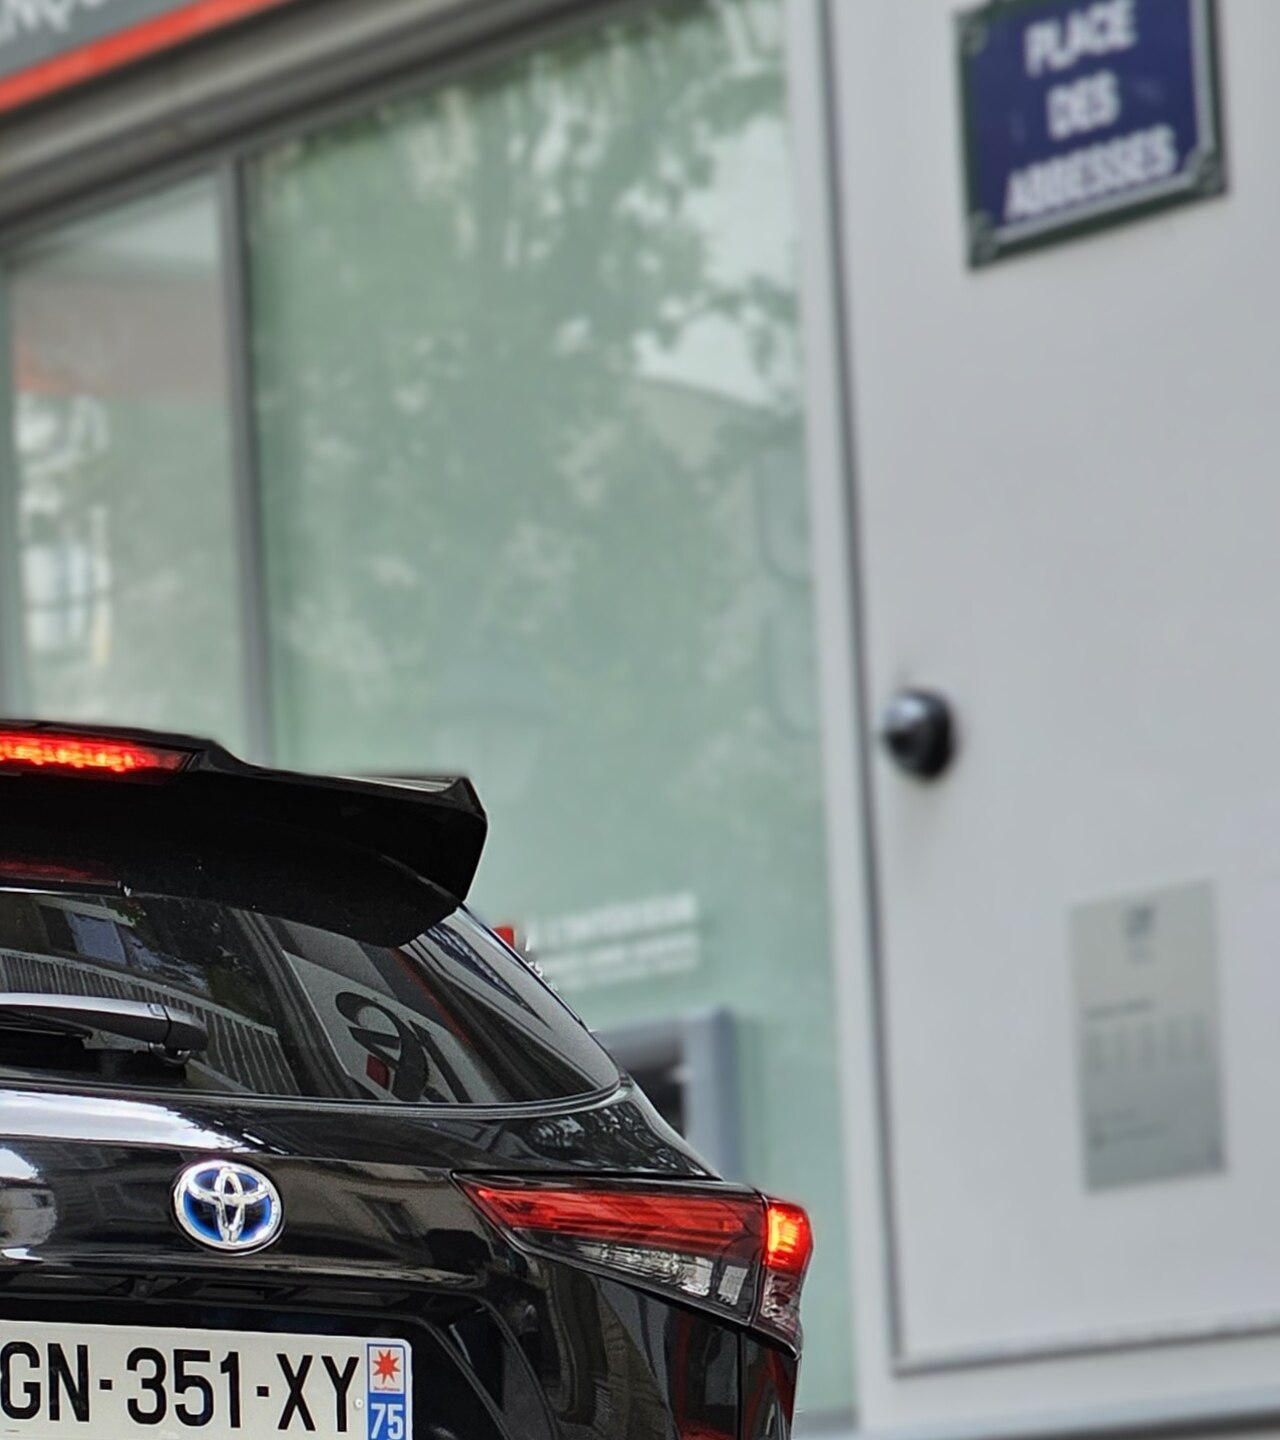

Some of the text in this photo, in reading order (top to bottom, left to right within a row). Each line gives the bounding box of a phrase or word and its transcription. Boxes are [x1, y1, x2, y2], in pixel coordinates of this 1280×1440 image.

[1025, 1, 1136, 75] PLACE
[1047, 70, 1120, 139] DES
[0, 1341, 359, 1432] GN-351-XY
[370, 1402, 404, 1440] 75
